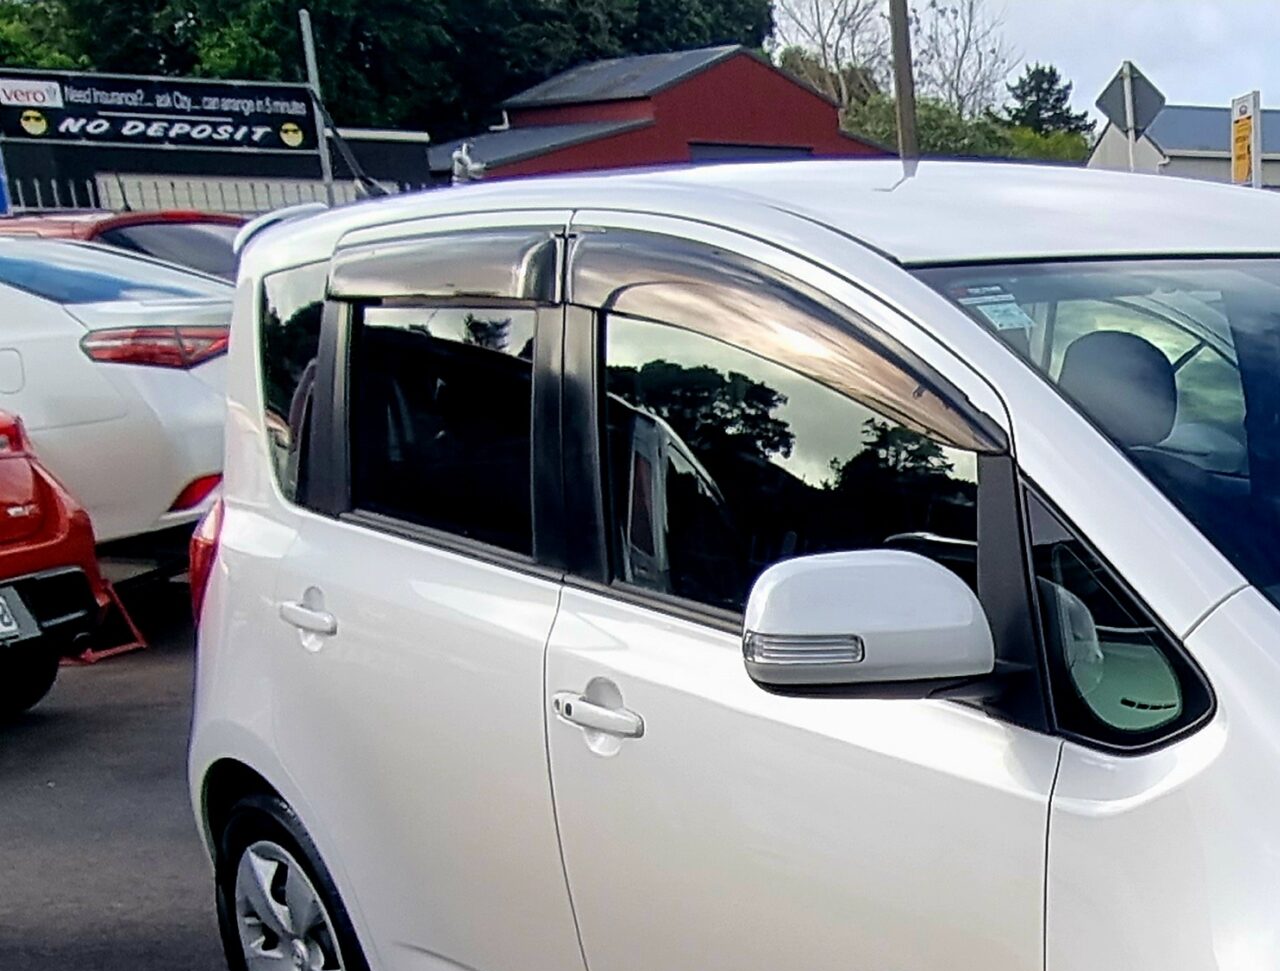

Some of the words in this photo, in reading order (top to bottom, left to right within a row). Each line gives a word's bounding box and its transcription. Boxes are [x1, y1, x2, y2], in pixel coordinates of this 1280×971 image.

[2, 88, 46, 103] vero
[58, 117, 110, 134] NO
[121, 120, 273, 142] DEPOSIT
